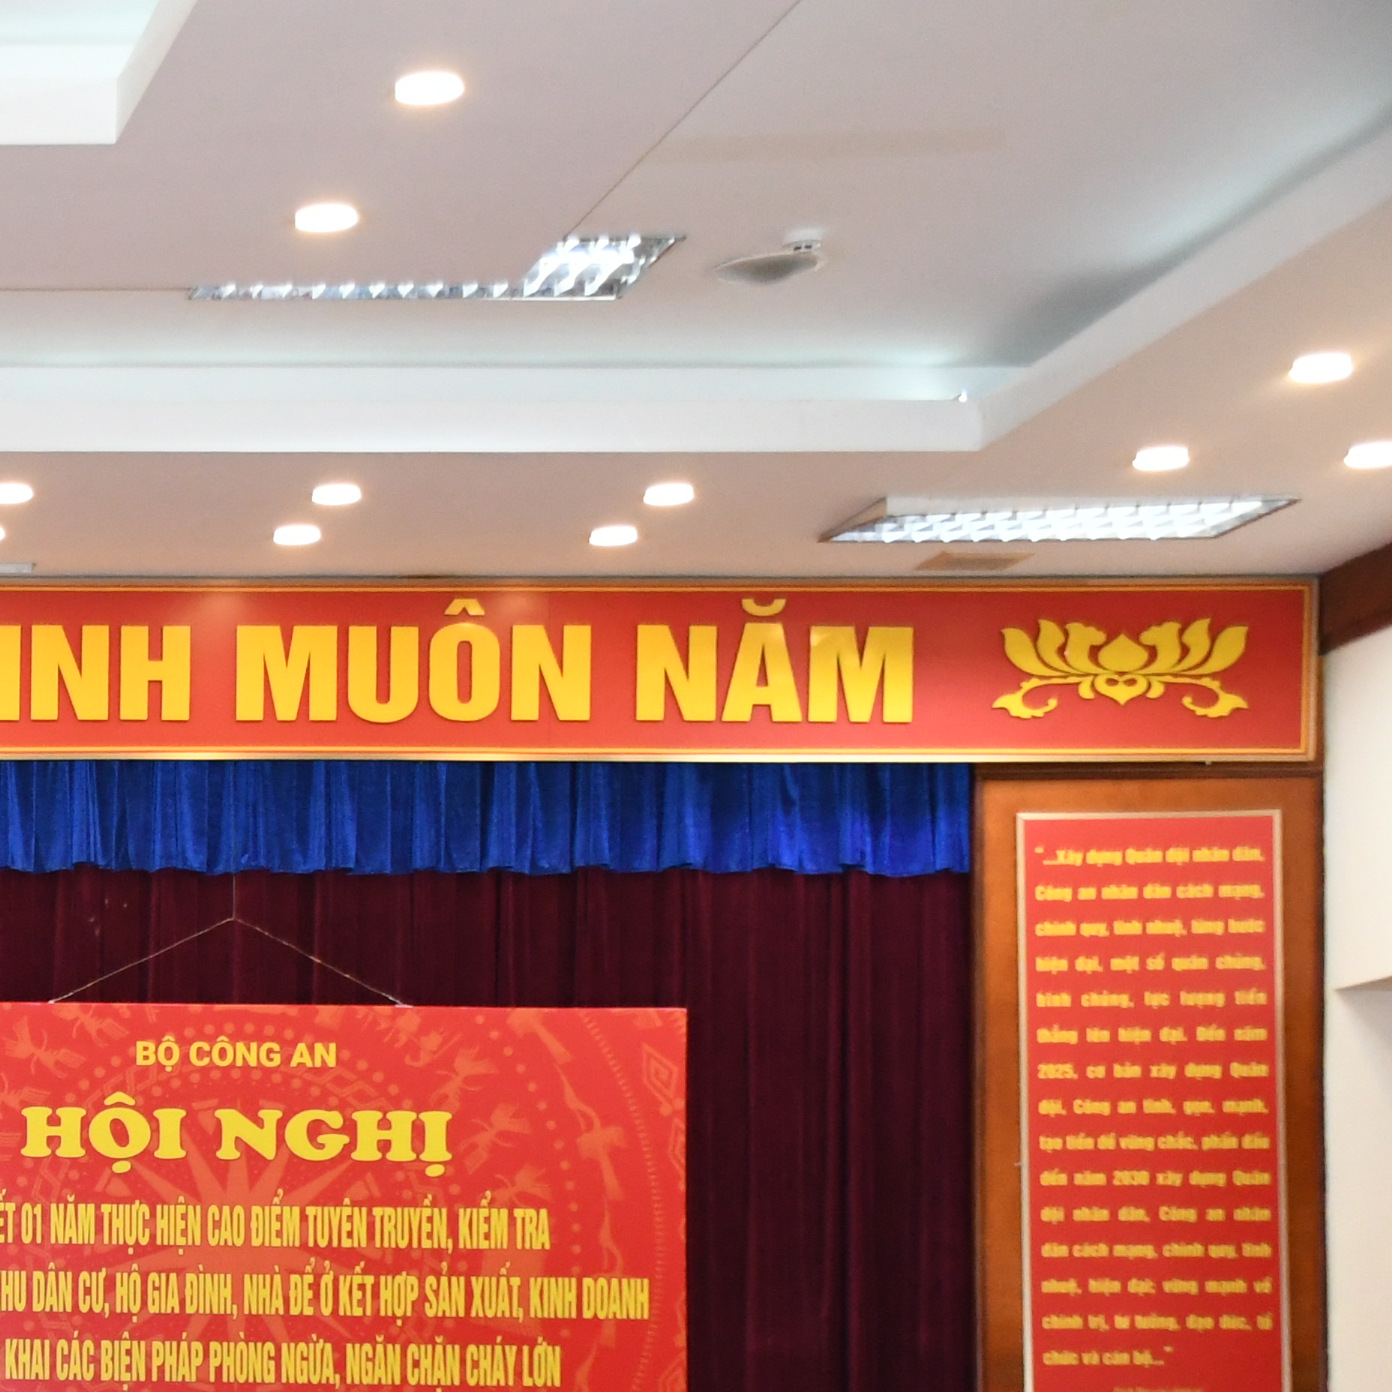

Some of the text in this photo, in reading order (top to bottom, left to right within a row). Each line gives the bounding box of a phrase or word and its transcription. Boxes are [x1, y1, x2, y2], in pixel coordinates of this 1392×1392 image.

[235, 602, 593, 724] MUÔN
[635, 598, 916, 724] NĂM
[136, 1035, 337, 1073] BỘ CÔNG AN
[20, 1091, 452, 1177] HỘI NGHỊ
[21, 1203, 42, 1244] 01
[50, 1195, 95, 1245] NĂM
[101, 1200, 151, 1255] THỰC
[156, 1196, 201, 1256] HIỆN
[207, 1204, 245, 1247] CAO
[251, 1188, 300, 1248] ĐIỂM
[306, 1198, 367, 1249] TUYÊN
[373, 1194, 453, 1254] TRUYỀN,
[459, 1190, 508, 1250] KIỂM
[514, 1208, 551, 1250] TRA
[33, 1262, 72, 1312] DÂN
[78, 1271, 109, 1318] CƯ,
[115, 1264, 141, 1323] HỘ
[147, 1273, 180, 1314] GIA
[185, 1265, 237, 1319] ĐÌNH,
[243, 1262, 284, 1315] NHÀ
[289, 1257, 314, 1315] ĐỂ
[320, 1263, 333, 1317] Ở
[339, 1261, 373, 1317] KẾT
[379, 1271, 418, 1326] HỢP
[424, 1263, 465, 1318] SẢN
[471, 1261, 524, 1323] XUẤT,
[530, 1277, 577, 1319] KINH
[583, 1278, 649, 1319] DOANH
[5, 1338, 50, 1380] KHAI
[56, 1331, 94, 1381] CÁC
[100, 1331, 145, 1390] BIỆN
[152, 1331, 203, 1382] PHÁP
[209, 1331, 275, 1384] PHÒNG
[281, 1333, 340, 1390] NGỪA,
[346, 1336, 401, 1386] NGĂN
[465, 1335, 517, 1386] CHÁY
[522, 1335, 560, 1387] LỚN
